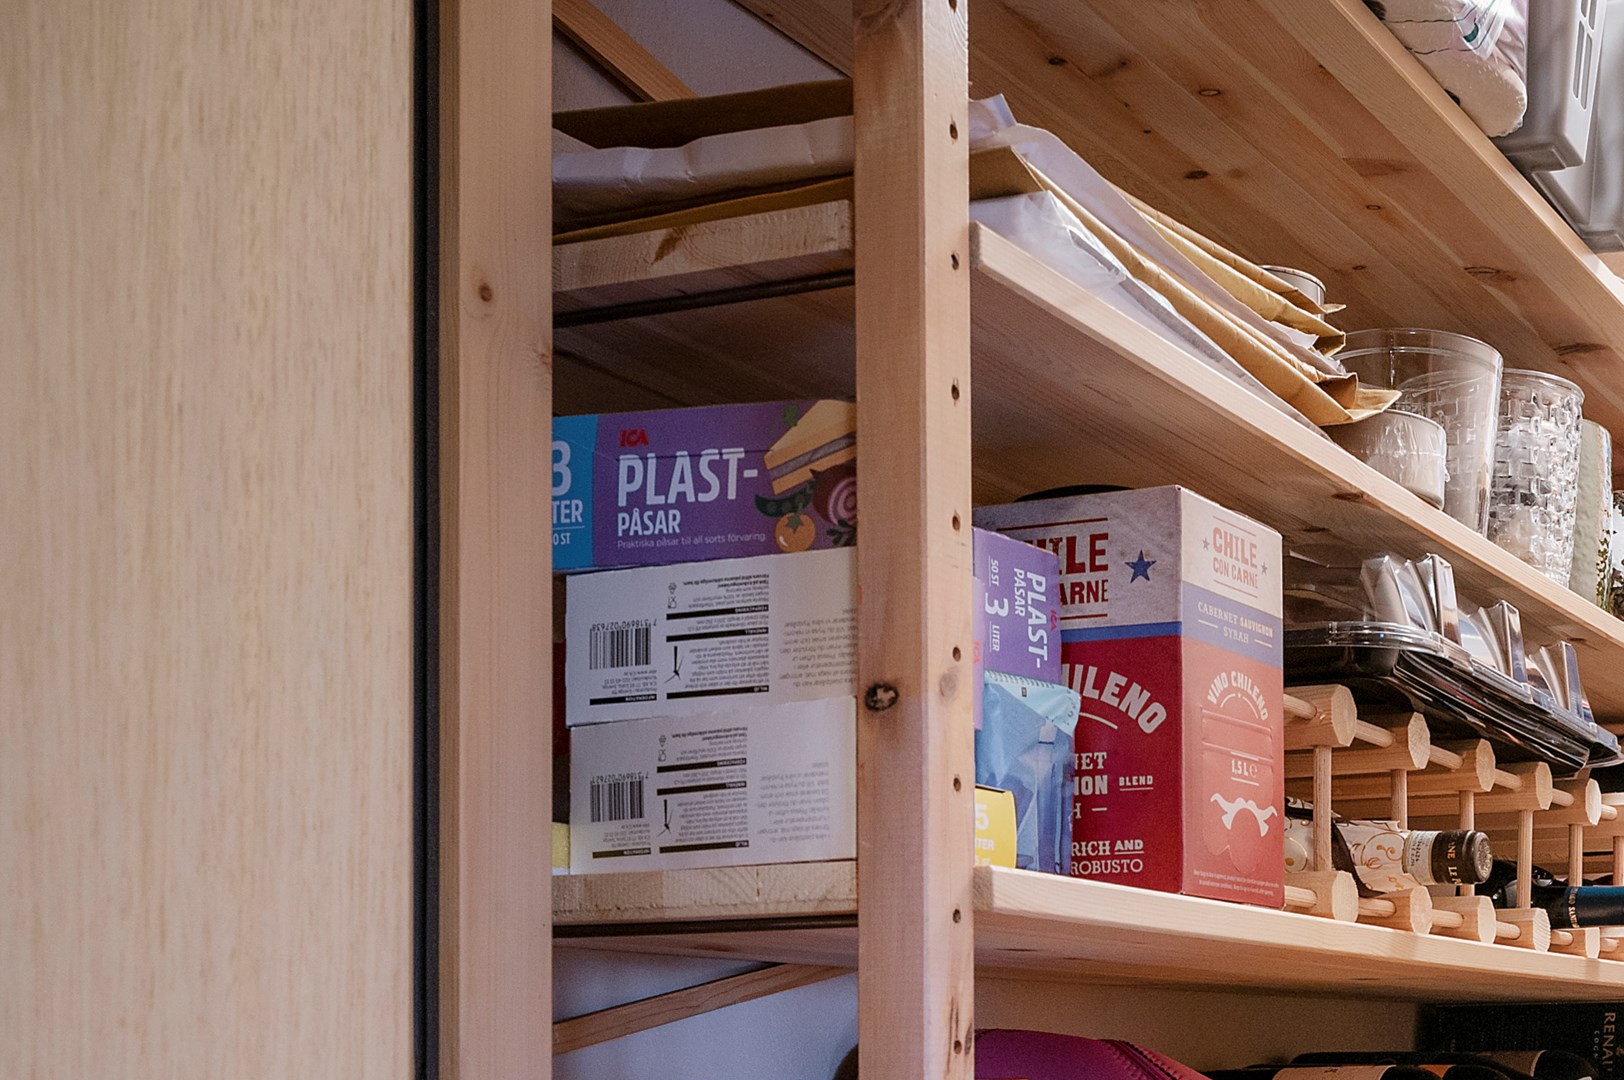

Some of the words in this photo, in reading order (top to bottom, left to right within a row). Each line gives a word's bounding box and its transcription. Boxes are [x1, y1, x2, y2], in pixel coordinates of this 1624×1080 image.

[619, 429, 649, 448] ICA
[618, 448, 758, 507] PLAST-
[617, 507, 681, 537] PÅSAR
[560, 532, 571, 544] ST
[617, 538, 655, 549] Praktiska
[656, 536, 679, 548] påsar
[681, 535, 693, 546] till
[694, 535, 704, 545] all
[704, 534, 726, 545] sorts
[727, 531, 766, 544] förvaring
[1213, 527, 1258, 569] CHILE
[993, 574, 999, 586] ST
[1213, 557, 1229, 578] CON
[1232, 564, 1258, 589] CARNE
[985, 592, 1009, 617] 3
[1027, 571, 1048, 669] PLAST-
[1198, 601, 1238, 624] CABERNET
[1240, 616, 1273, 639] SAUVIGNON
[992, 624, 1000, 652] LITER
[1223, 625, 1250, 644] SYRAH
[1207, 671, 1228, 705] VINO
[1231, 671, 1268, 720] CHILENO
[1119, 775, 1153, 786] BLEND
[1071, 840, 1111, 856] RICH
[1115, 839, 1143, 852] AND
[1071, 859, 1143, 875] ROBUSTO
